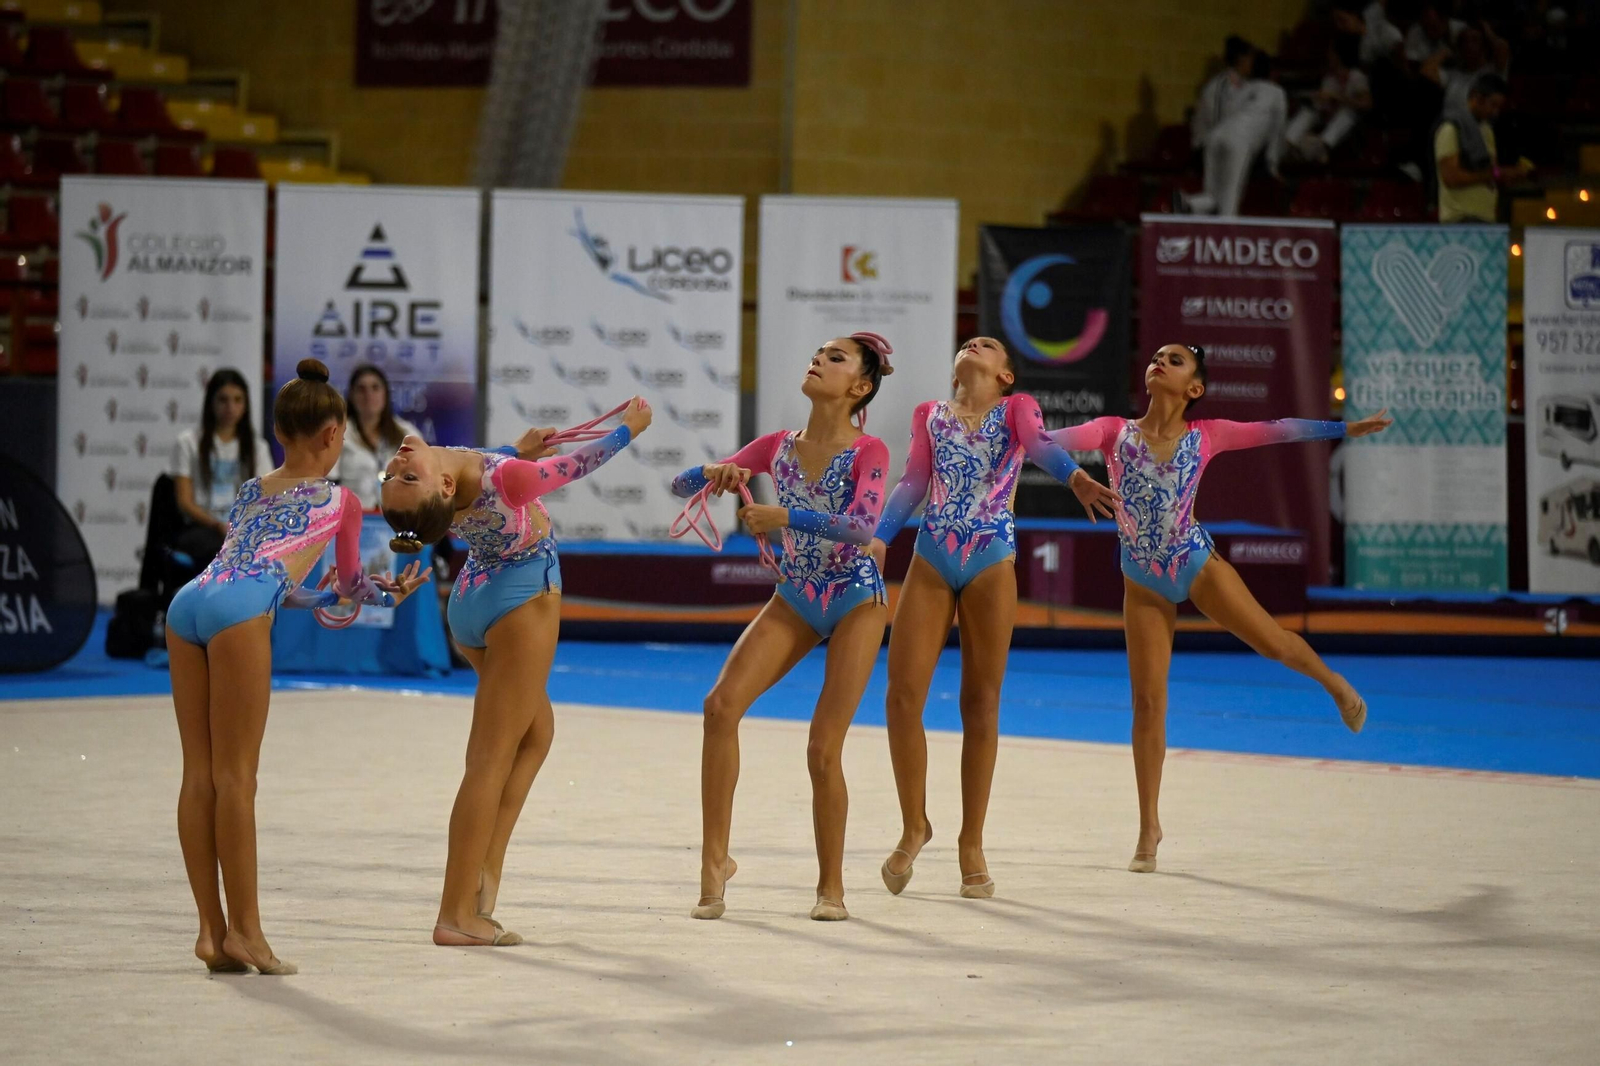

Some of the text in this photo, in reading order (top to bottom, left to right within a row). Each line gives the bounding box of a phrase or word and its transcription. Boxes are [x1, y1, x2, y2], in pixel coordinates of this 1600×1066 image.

[127, 233, 227, 254] COLEGIO
[1195, 236, 1319, 268] IMDECO
[127, 255, 253, 276] ALMANZOR
[313, 300, 441, 338] AIRE
[1207, 297, 1294, 320] IMDECO
[1214, 345, 1276, 363] IMDECO
[1536, 329, 1568, 354] 957
[1352, 378, 1501, 411] fisioterapia
[1033, 542, 1059, 572] 1
[1544, 607, 1567, 634] 3
